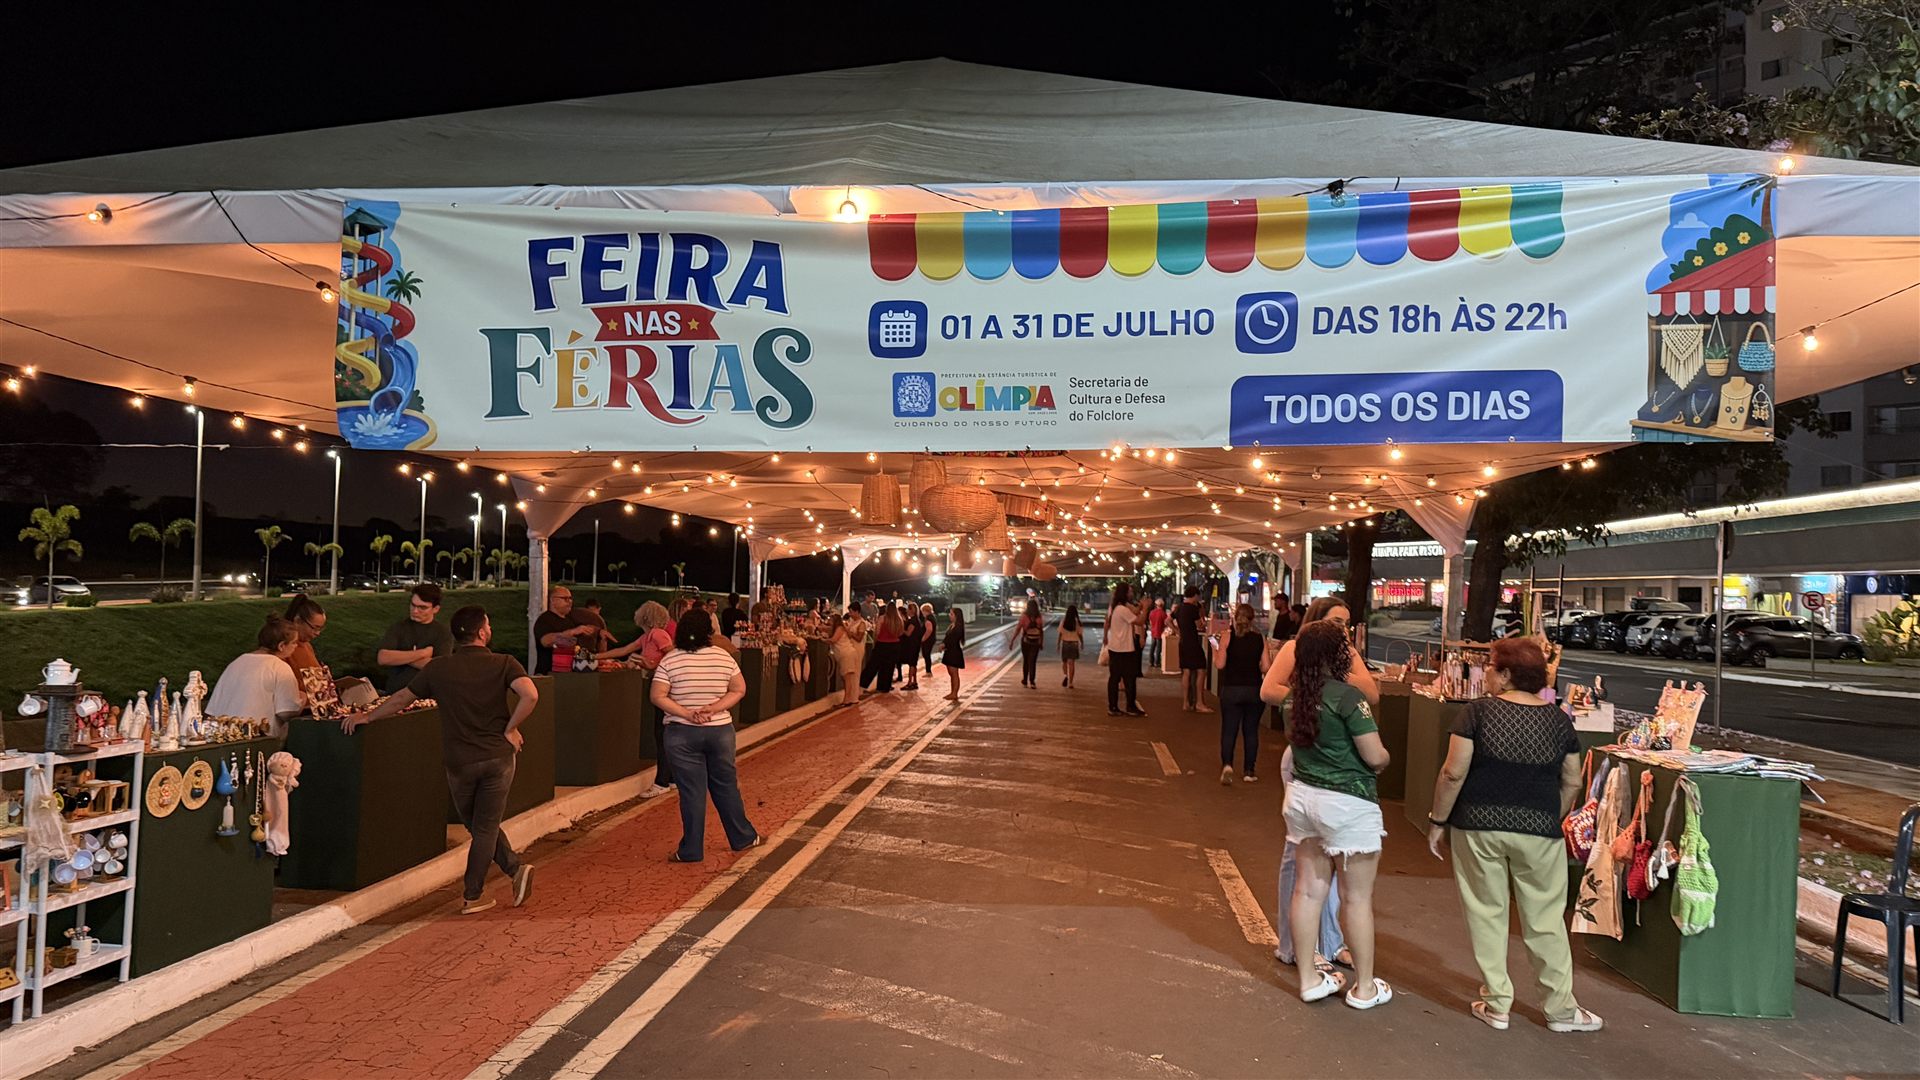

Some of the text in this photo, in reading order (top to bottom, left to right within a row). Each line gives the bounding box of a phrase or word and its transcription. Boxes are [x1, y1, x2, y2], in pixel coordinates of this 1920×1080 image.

[527, 232, 790, 315] FEIRA
[623, 311, 682, 336] NAS
[941, 308, 1215, 340] 01 A 31 DE JULHO
[1312, 296, 1568, 335] DAS 18h ÀS 22h
[478, 326, 815, 429] FÉRIAS
[1069, 376, 1149, 388] Secretaria de
[938, 379, 1057, 412] OLÍMPIA
[1069, 392, 1166, 405] Cultura e Defesa
[1264, 390, 1531, 424] TODOS OS DIAS
[1069, 409, 1134, 421] do Folclore
